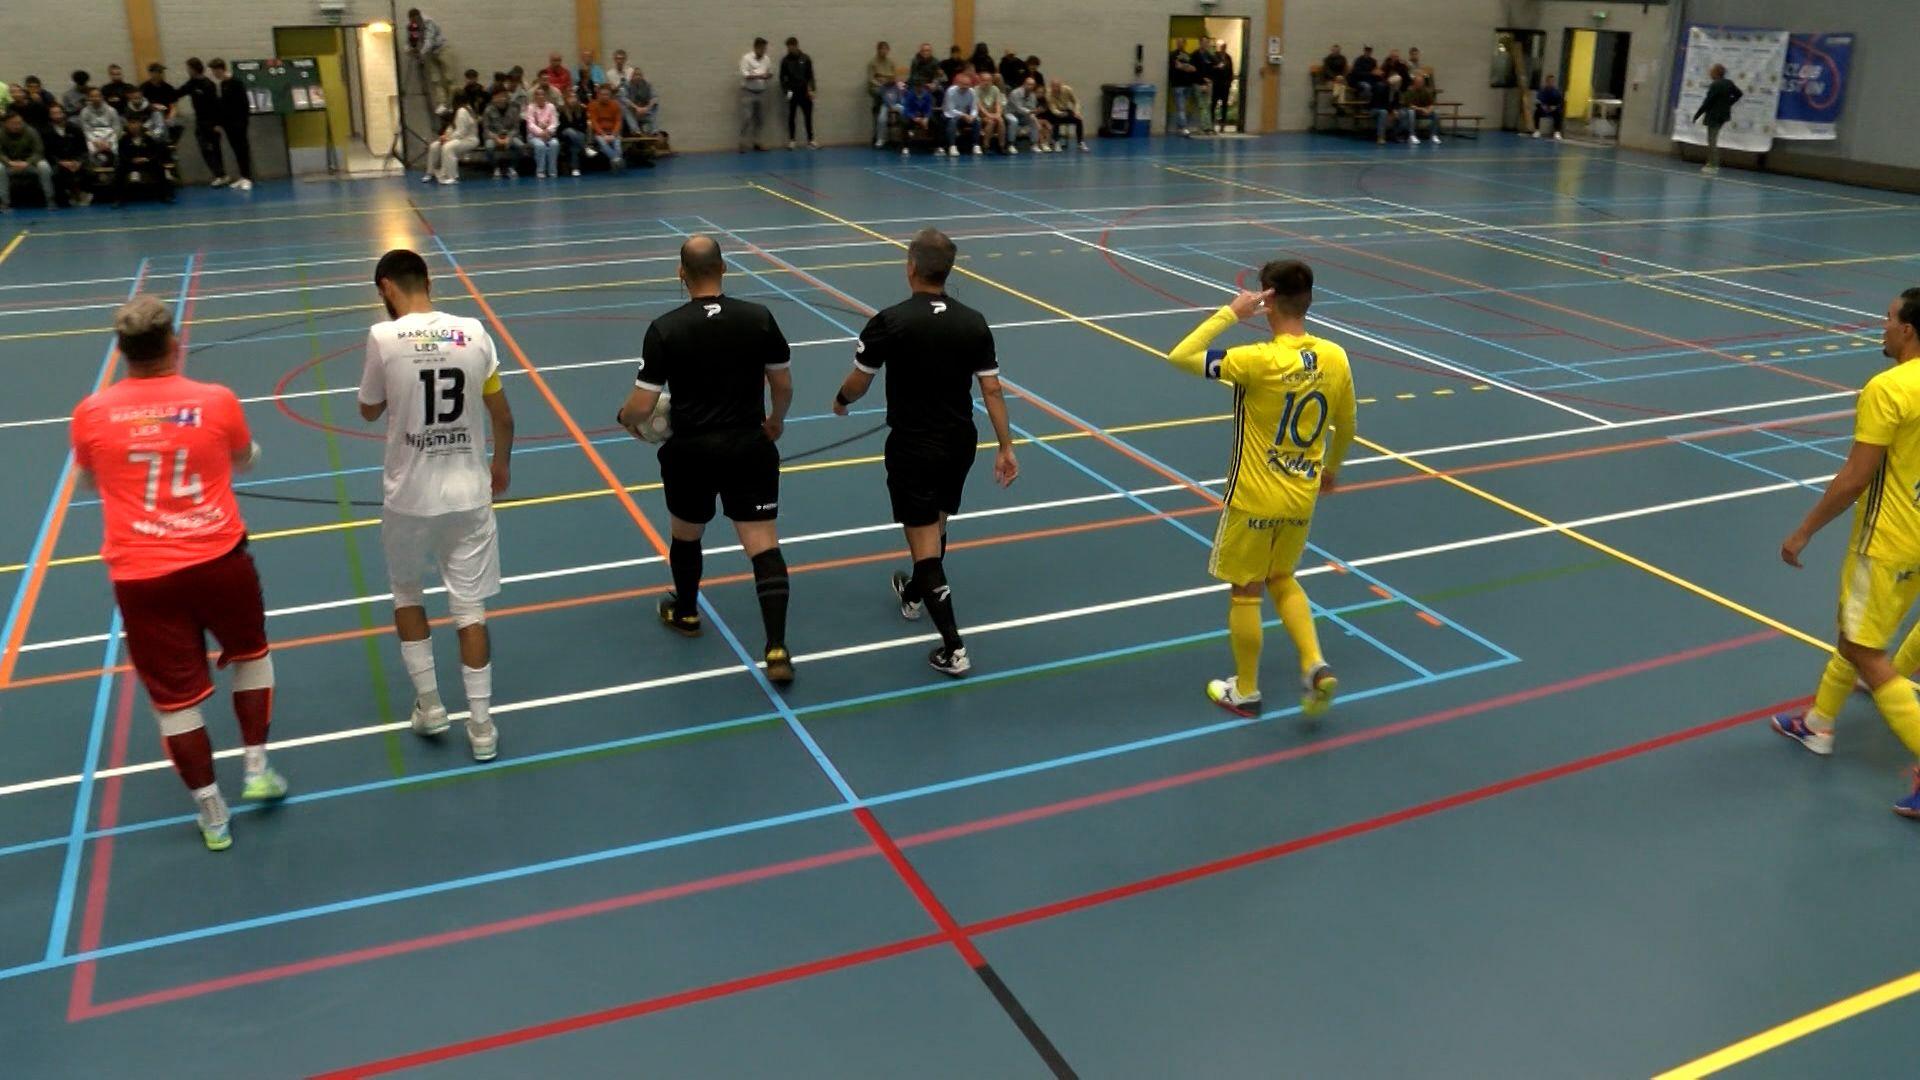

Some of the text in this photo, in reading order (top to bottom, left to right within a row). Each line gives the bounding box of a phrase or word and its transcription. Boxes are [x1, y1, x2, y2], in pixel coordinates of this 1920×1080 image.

[419, 367, 466, 425] 13
[1275, 390, 1328, 448] 10
[128, 449, 204, 512] 74
